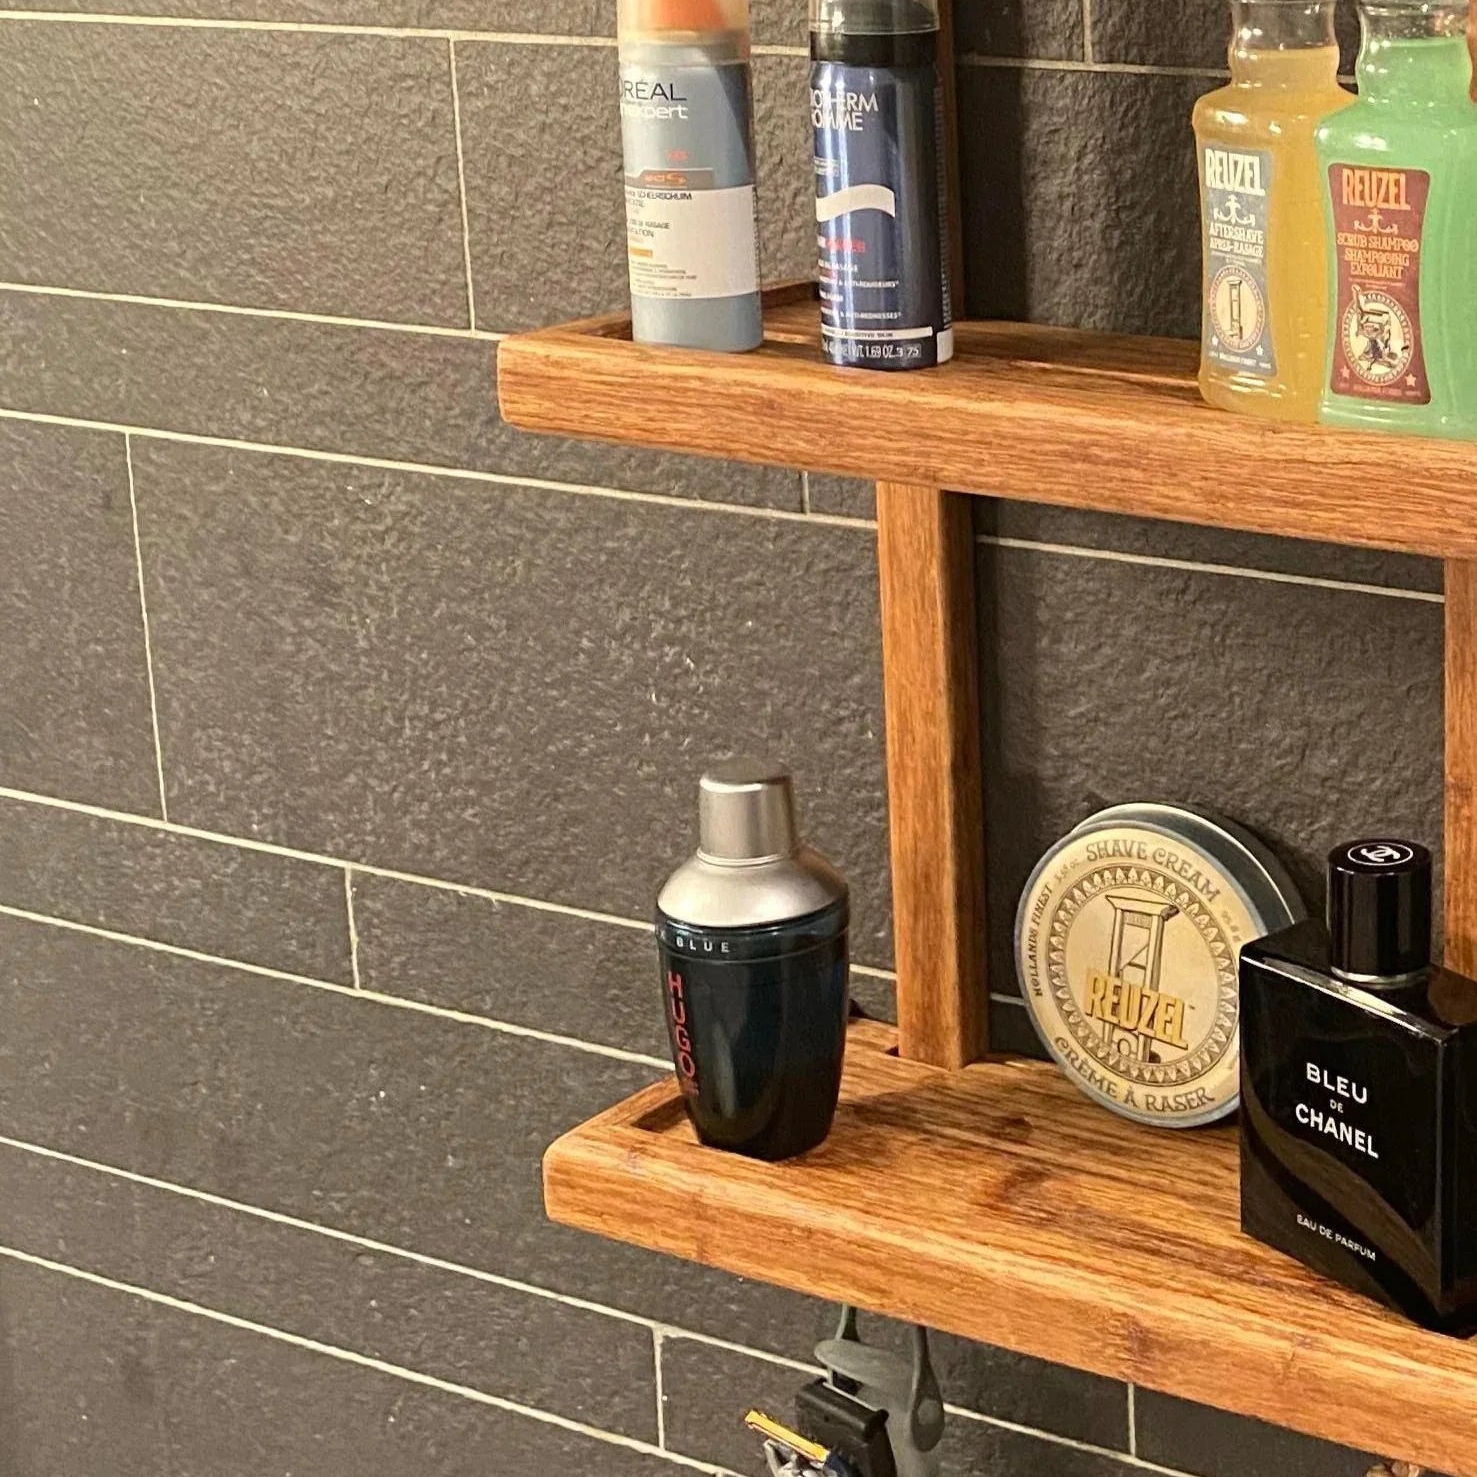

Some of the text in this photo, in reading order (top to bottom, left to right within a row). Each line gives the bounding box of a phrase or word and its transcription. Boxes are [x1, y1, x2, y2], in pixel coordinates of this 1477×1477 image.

[1204, 147, 1267, 197] REUZEL
[1341, 167, 1412, 211] REUZEL
[1336, 231, 1420, 253] SCRUB SHAMPOO
[1350, 260, 1405, 279] EXFOLIANT
[1086, 838, 1222, 902] SHAVE CREAM
[675, 935, 731, 953] BLUE
[1027, 884, 1054, 998] HOLLANDS FINEST
[667, 969, 697, 1078] HUGO
[1083, 968, 1189, 1051] REUZEL
[1053, 1036, 1118, 1099] CRÈME
[1145, 1085, 1216, 1112] RASER
[1306, 1061, 1368, 1104] BLEU
[1329, 1098, 1344, 1114] DE
[1295, 1103, 1379, 1160] CHANEL
[1296, 1213, 1377, 1262] EAU DE PARFUM
